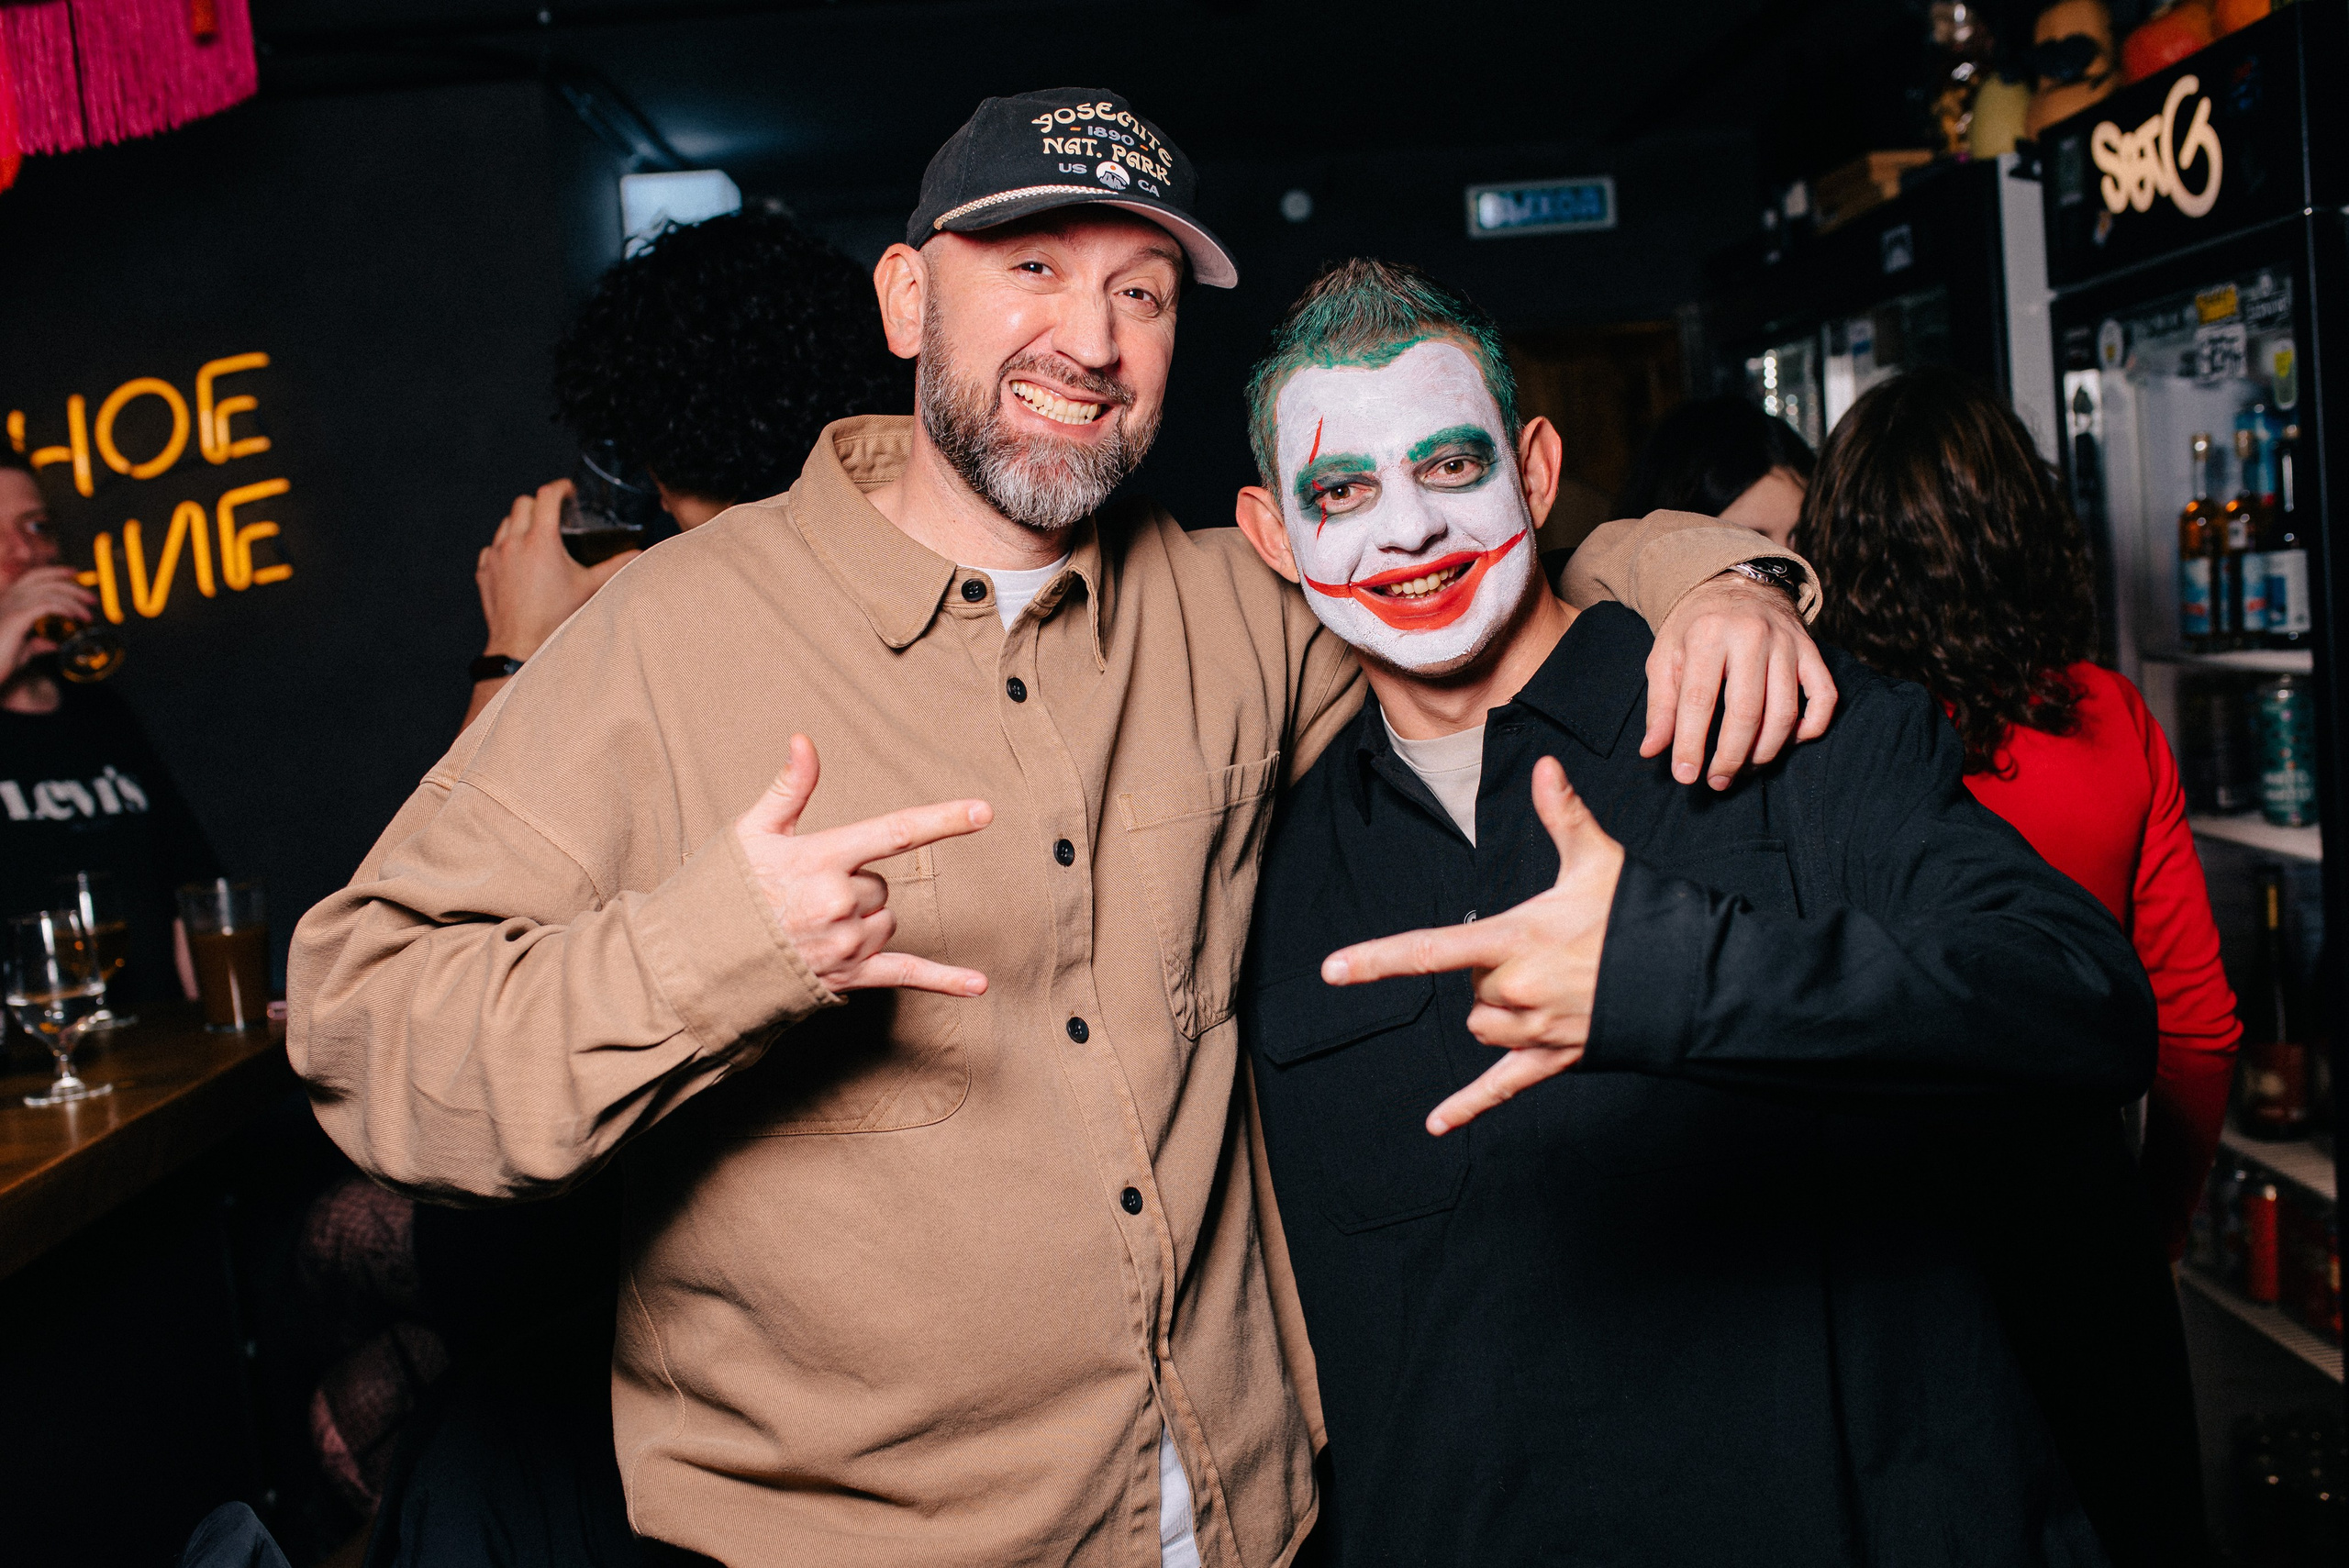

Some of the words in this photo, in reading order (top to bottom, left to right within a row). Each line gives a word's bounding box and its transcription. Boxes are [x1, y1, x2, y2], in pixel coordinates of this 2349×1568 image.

[1031, 102, 1174, 168] YOSEMITE
[1087, 125, 1135, 147] 1890
[1042, 138, 1103, 159] NAT.
[1111, 143, 1172, 186] PARK
[1058, 162, 1088, 174] US
[1137, 179, 1161, 198] CA
